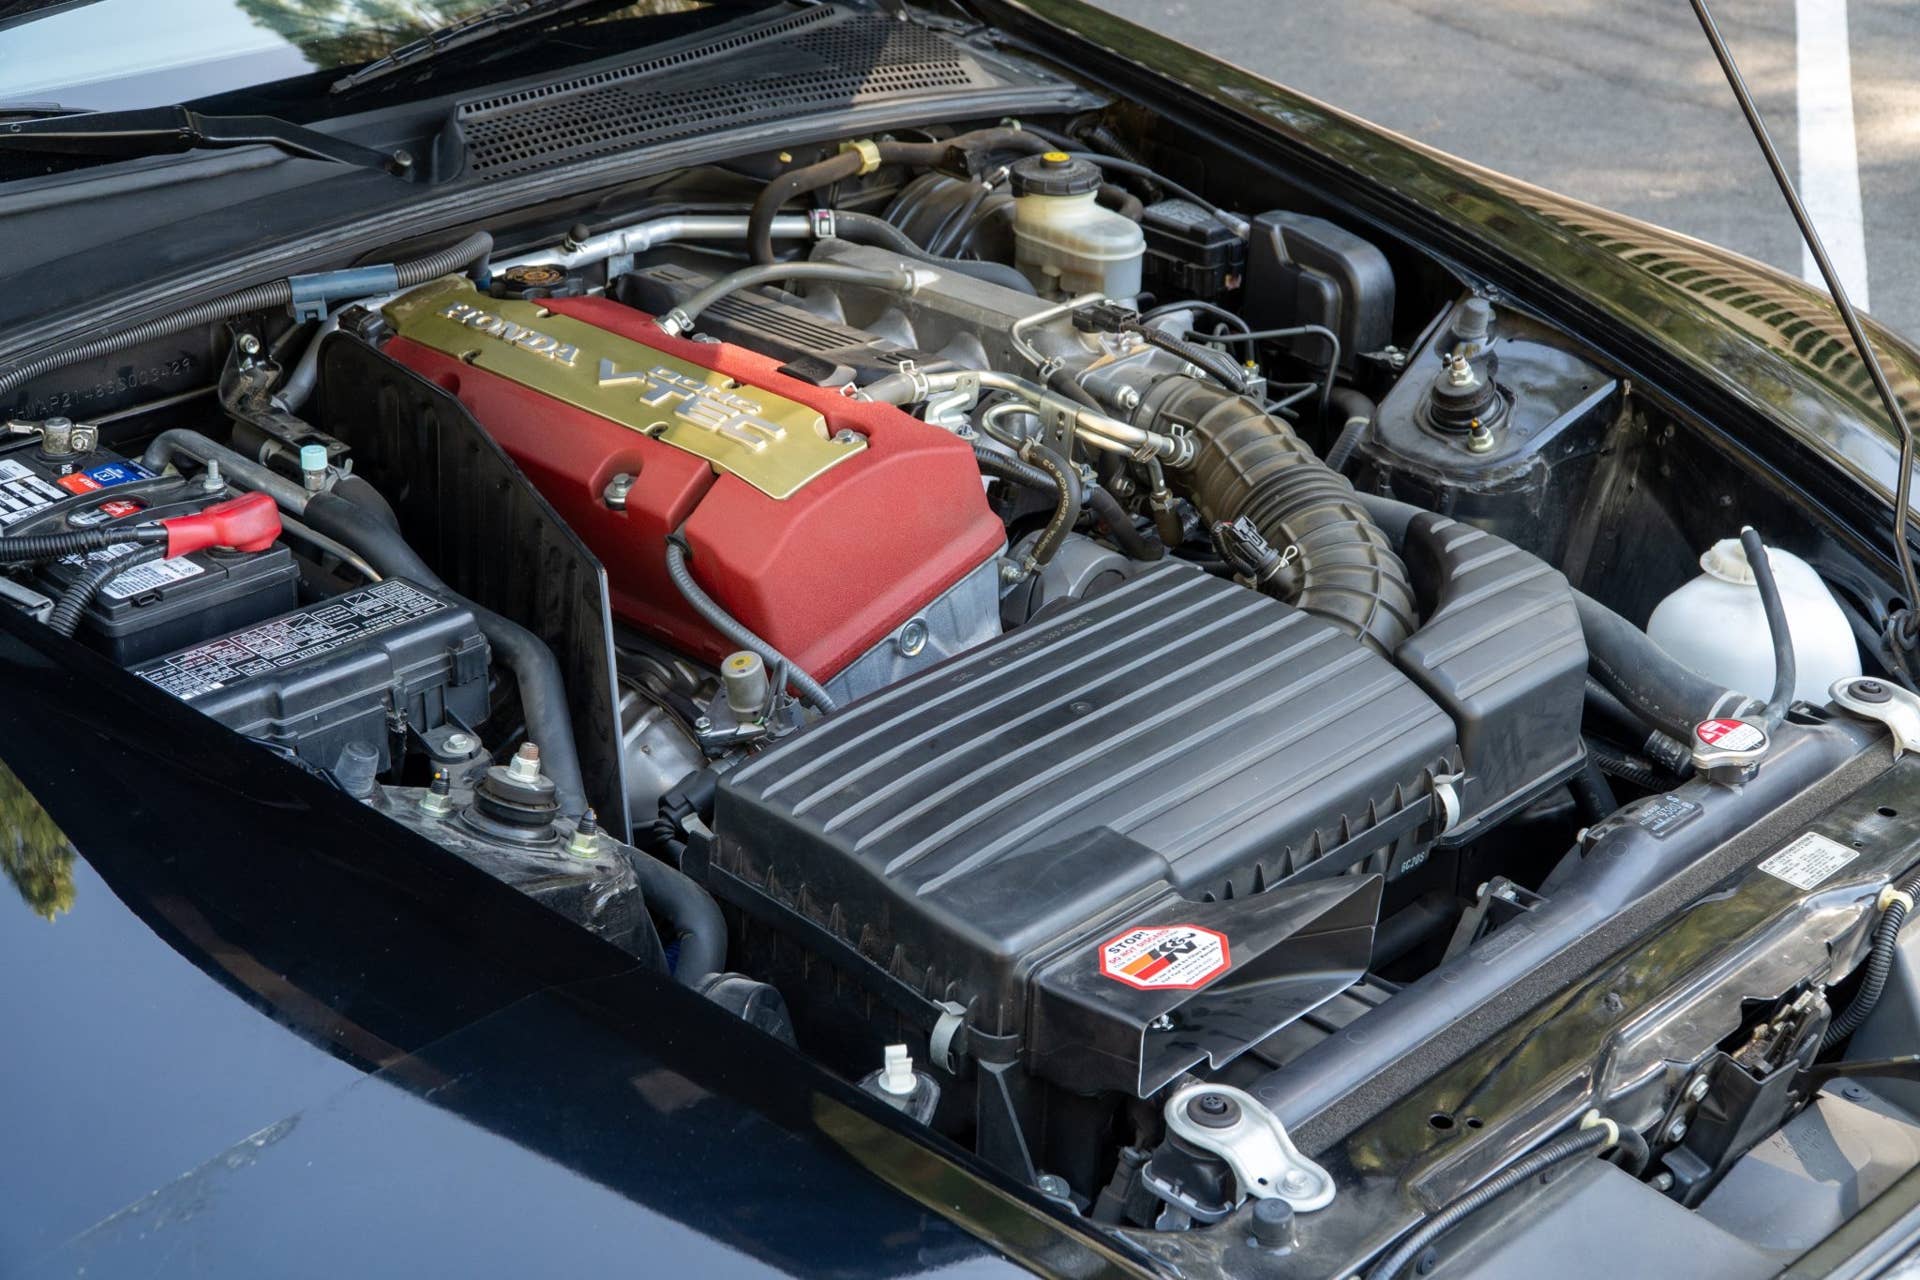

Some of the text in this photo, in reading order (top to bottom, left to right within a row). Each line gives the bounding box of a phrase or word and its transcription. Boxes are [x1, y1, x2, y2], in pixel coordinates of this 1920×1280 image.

[438, 302, 580, 367] HONDA
[598, 357, 787, 453] VTEC
[1108, 931, 1148, 954] STOP!
